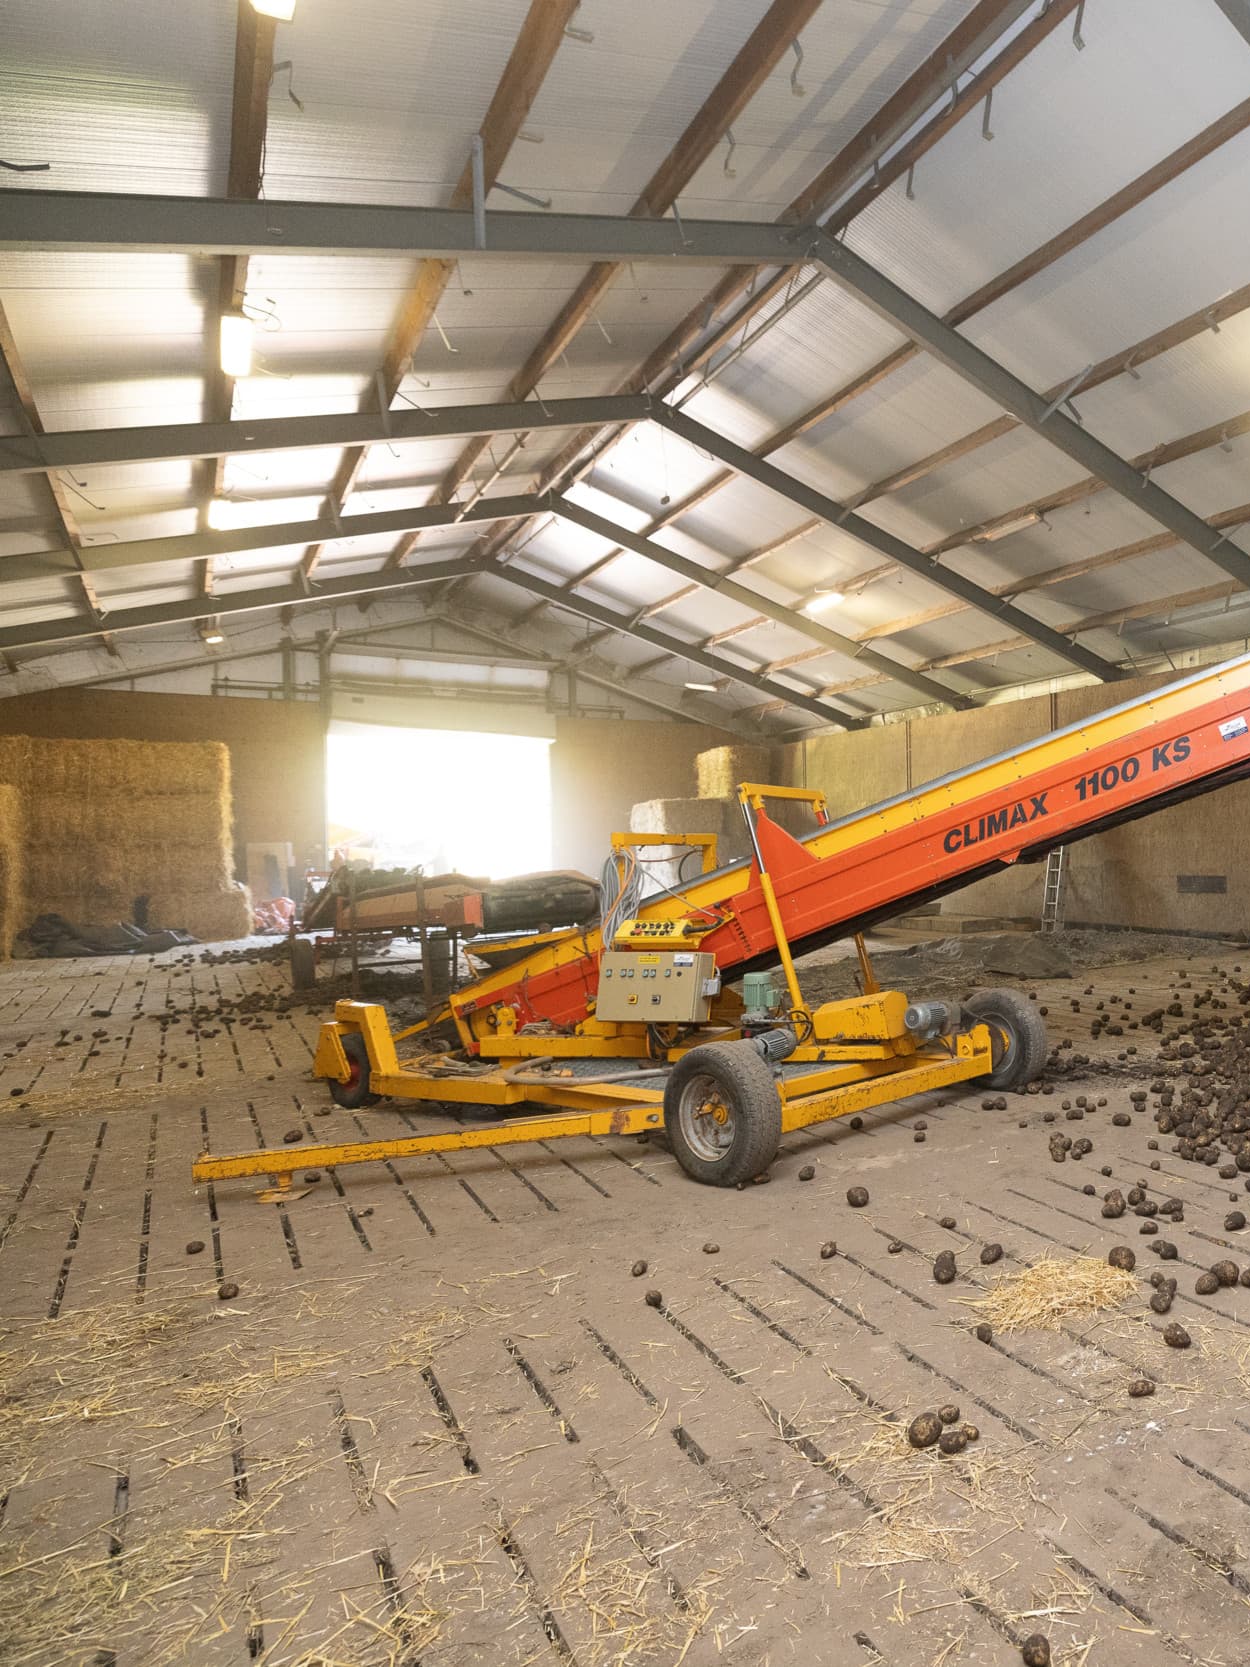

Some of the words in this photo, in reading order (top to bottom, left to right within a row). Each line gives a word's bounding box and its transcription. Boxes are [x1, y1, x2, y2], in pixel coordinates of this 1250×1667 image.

[943, 793, 1048, 853] CLIMAX
[1075, 757, 1139, 801] 1100
[1152, 736, 1191, 771] KS
